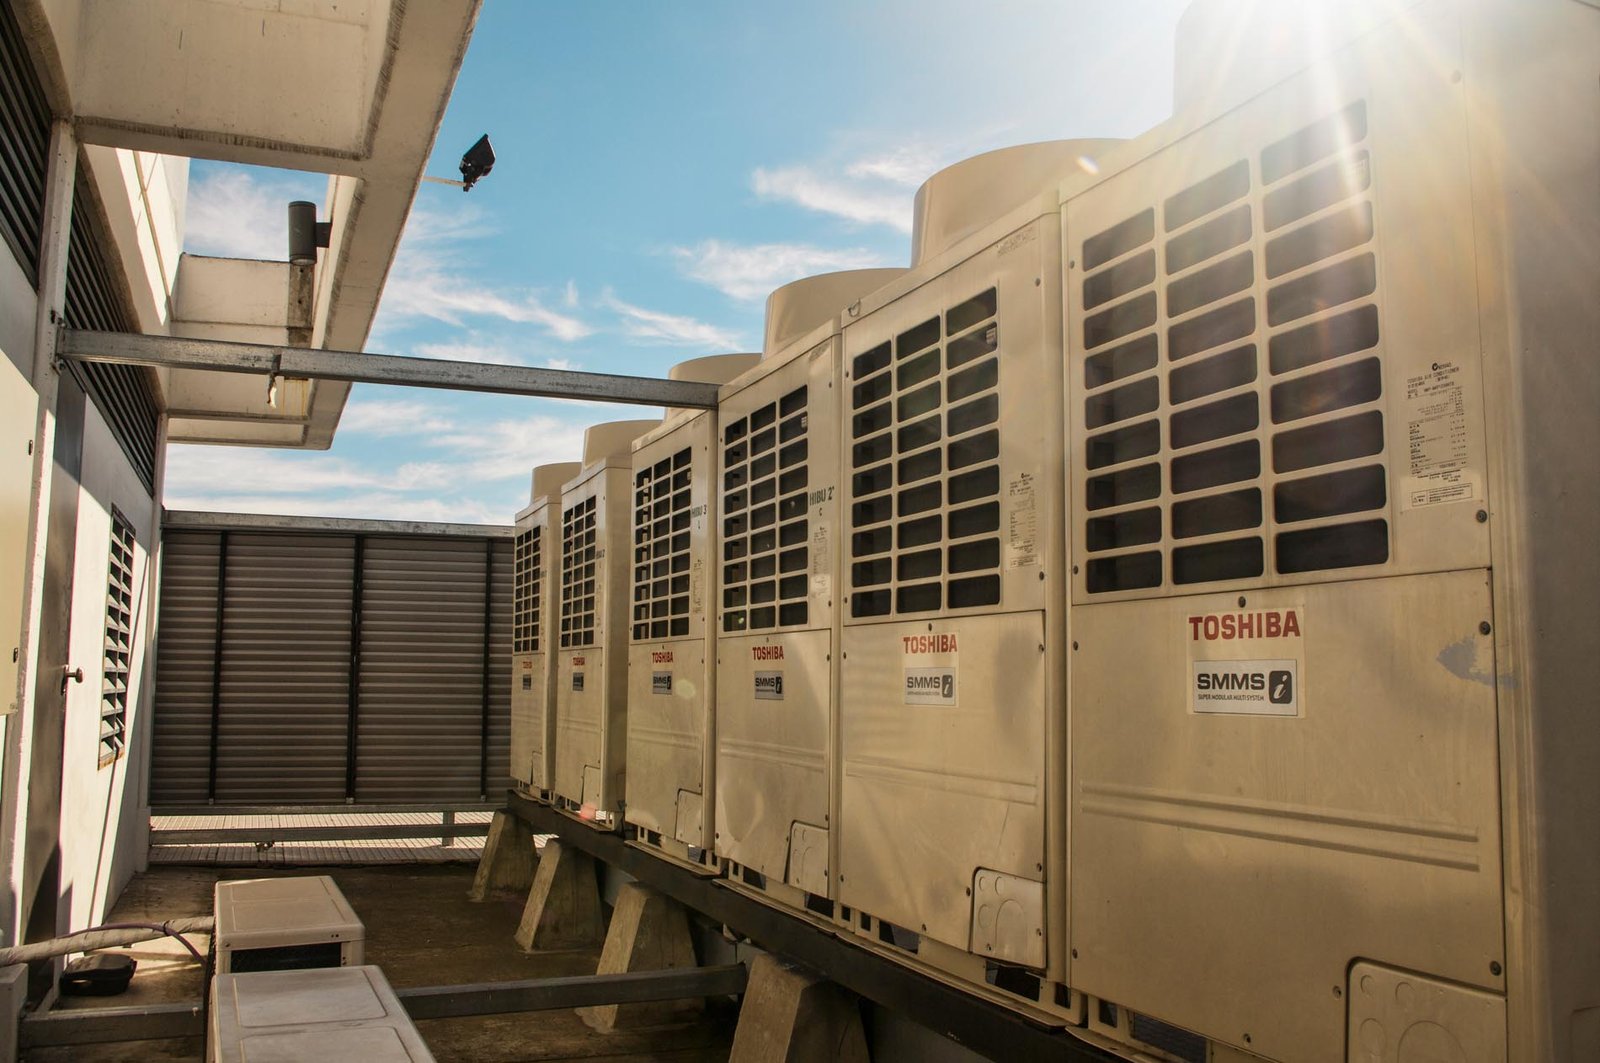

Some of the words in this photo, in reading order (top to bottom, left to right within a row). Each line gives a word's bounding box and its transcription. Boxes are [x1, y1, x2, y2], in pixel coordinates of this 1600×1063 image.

[1188, 611, 1301, 641] TOSHIBA
[903, 634, 957, 654] TOSHIBA
[752, 645, 784, 660] TOSHIBA
[755, 677, 775, 687] SMMS
[906, 676, 941, 689] SMMS
[1197, 673, 1265, 691] SMMS
[1198, 693, 1211, 701] SUPER
